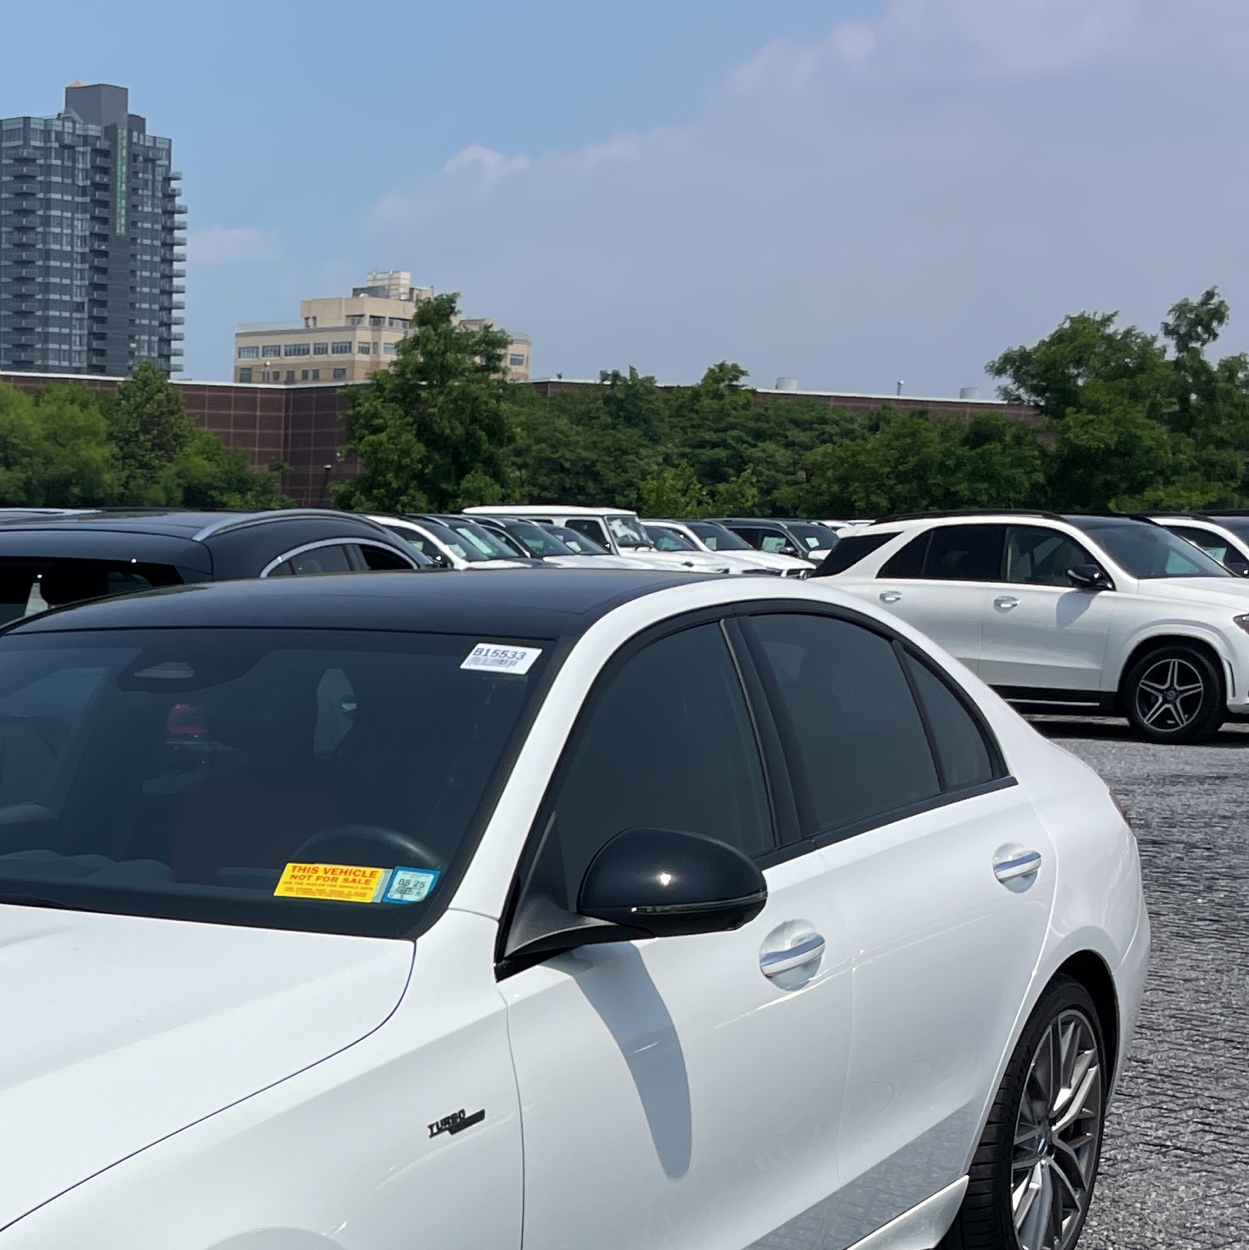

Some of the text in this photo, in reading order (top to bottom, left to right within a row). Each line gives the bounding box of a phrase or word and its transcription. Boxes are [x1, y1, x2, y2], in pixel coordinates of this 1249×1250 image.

[291, 865, 379, 879] THIS VEHICLE
[316, 875, 338, 883] FOR
[342, 877, 372, 886] SALE
[413, 880, 426, 889] 25
